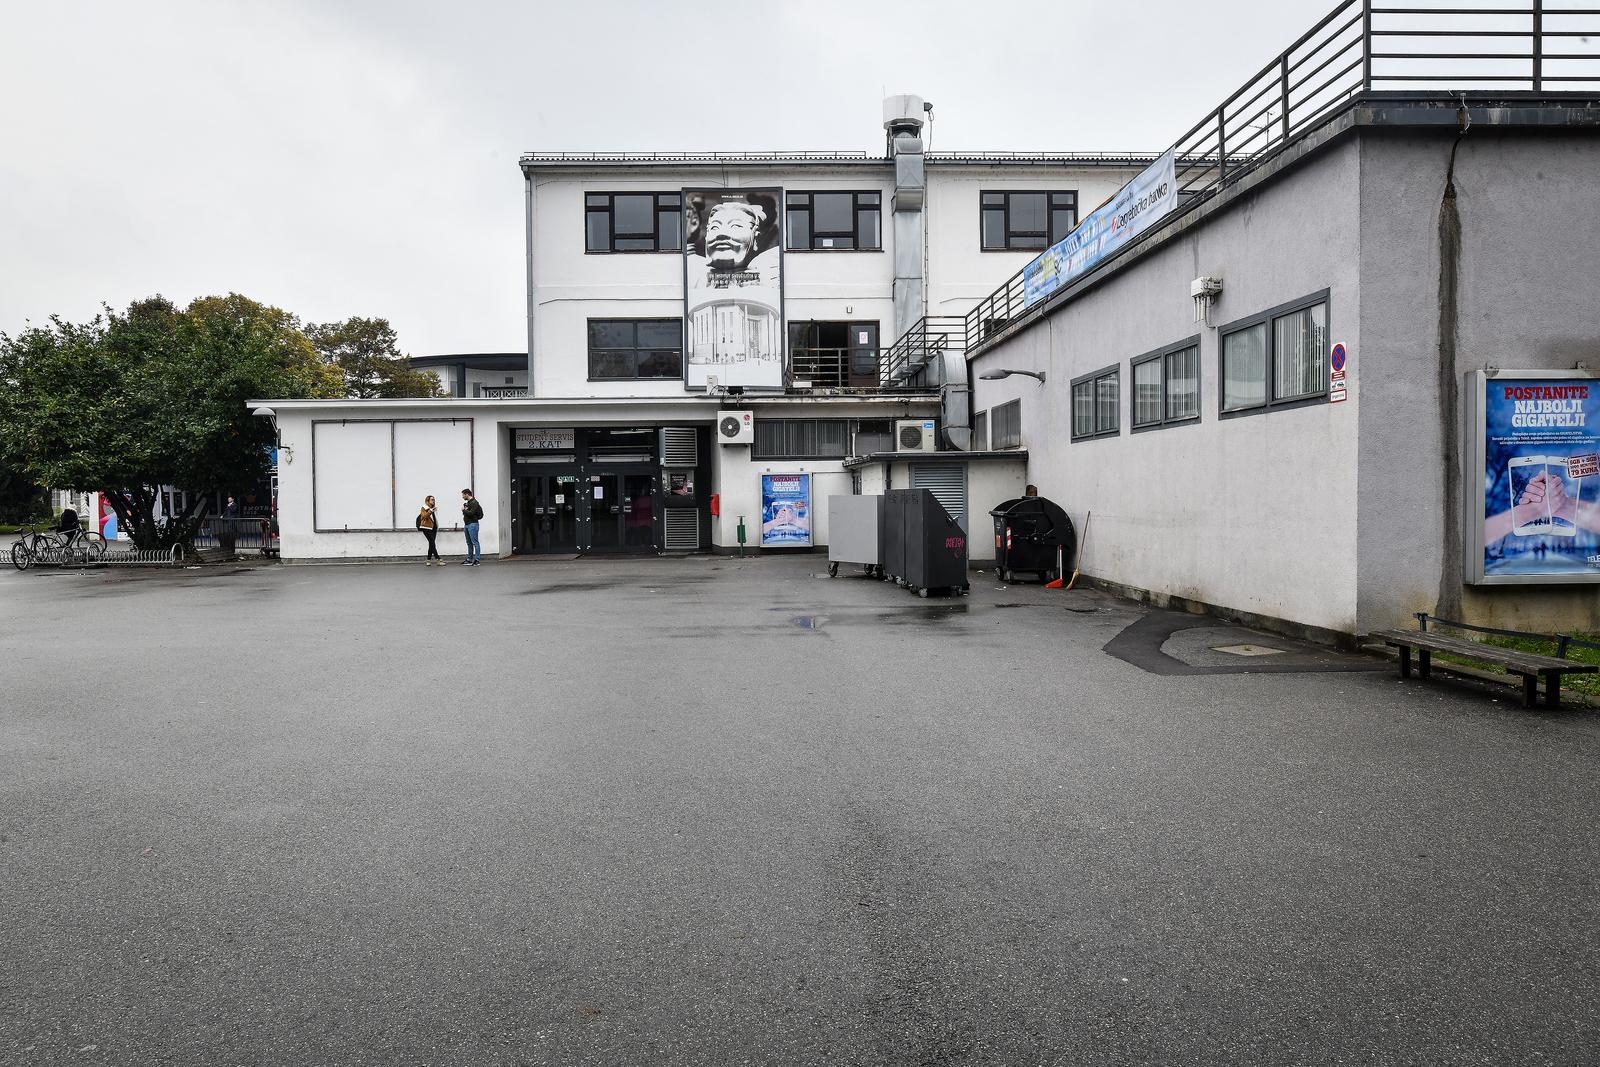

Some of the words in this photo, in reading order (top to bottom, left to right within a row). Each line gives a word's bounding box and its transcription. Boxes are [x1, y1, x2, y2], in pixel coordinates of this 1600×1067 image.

[1504, 386, 1589, 400] POSTANITE
[1514, 400, 1583, 414] NAJBOLJI
[1511, 413, 1586, 428] GIGATELJI
[516, 433, 548, 441] STUDENT
[549, 433, 574, 441] SERVIS
